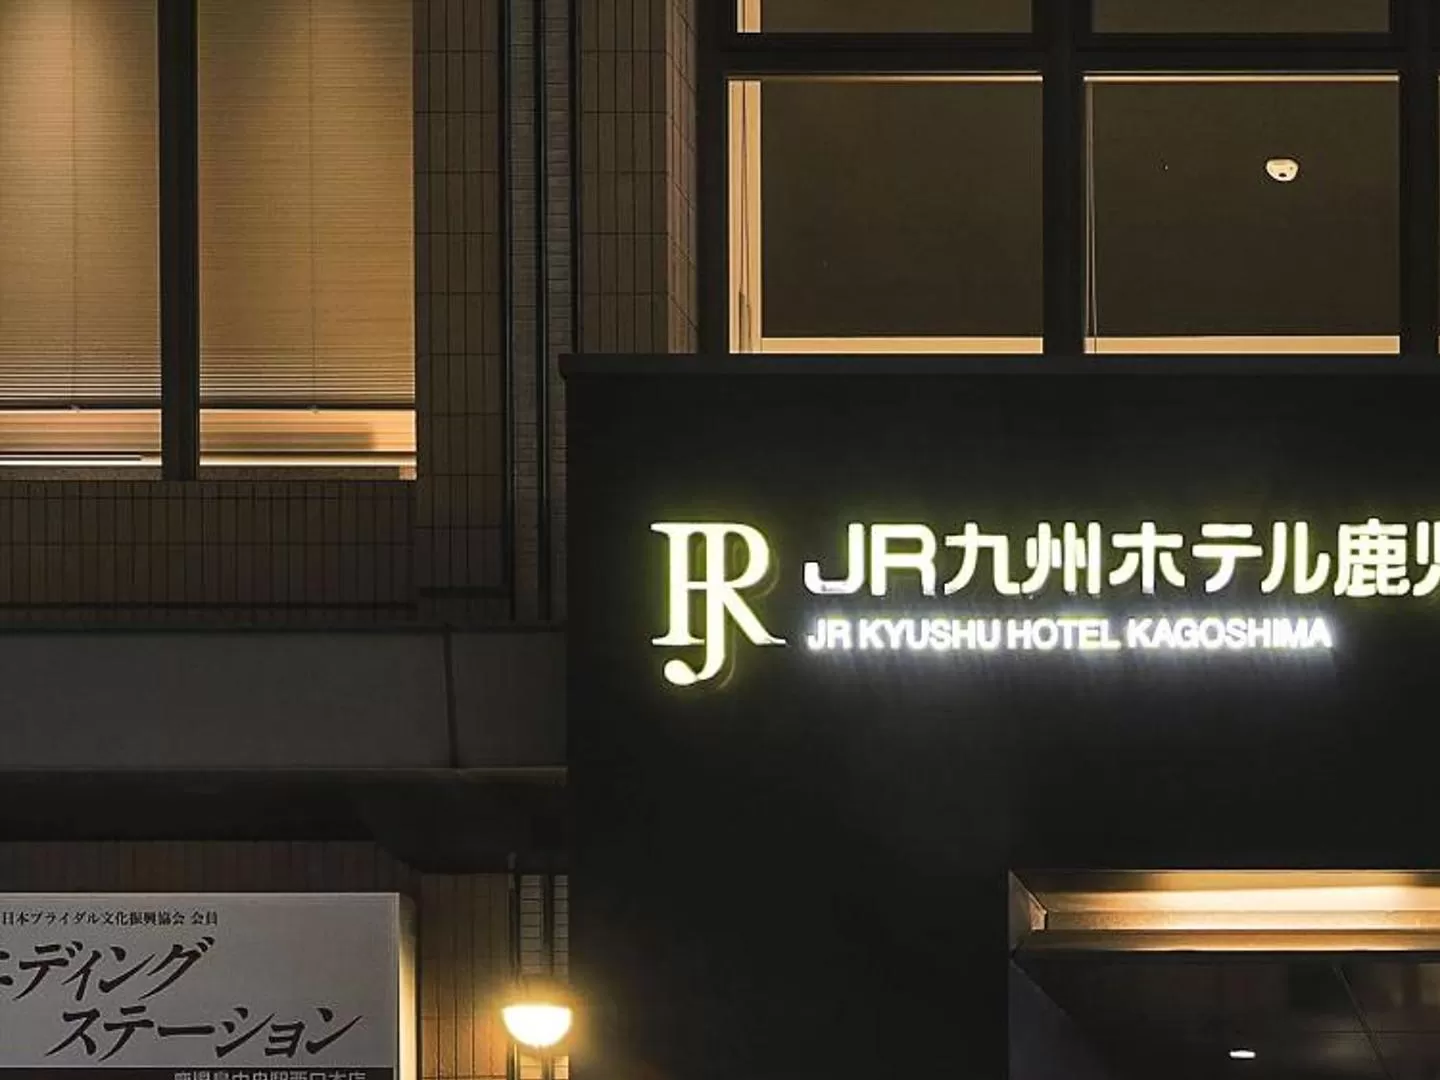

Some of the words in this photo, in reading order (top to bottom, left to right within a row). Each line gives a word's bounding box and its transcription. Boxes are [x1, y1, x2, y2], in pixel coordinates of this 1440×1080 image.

[807, 618, 850, 650] JR
[859, 618, 1001, 650] KYUSHU
[1006, 618, 1120, 650] HOTEL
[1126, 617, 1332, 650] KAGOSHIMA
[191, 910, 218, 926] 会員
[0, 936, 216, 1001] ディング
[44, 1005, 365, 1062] ステーション
